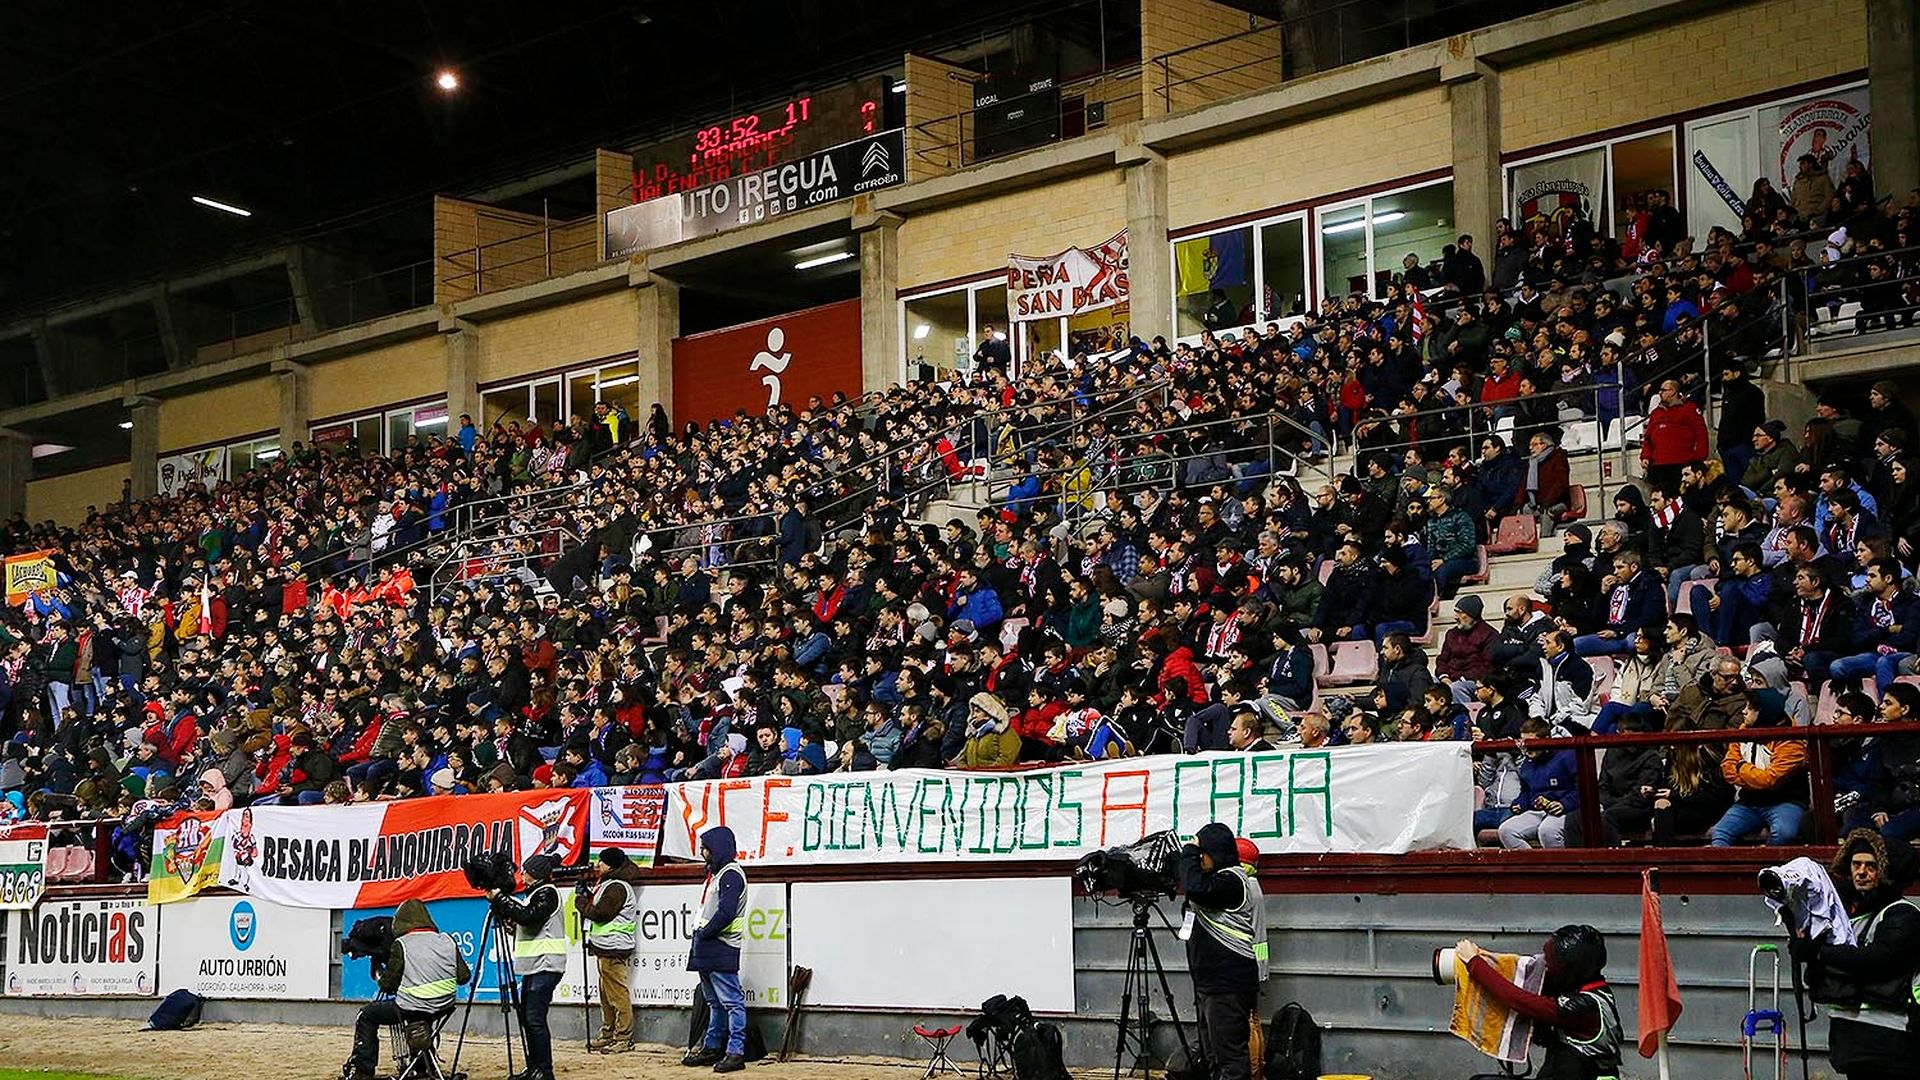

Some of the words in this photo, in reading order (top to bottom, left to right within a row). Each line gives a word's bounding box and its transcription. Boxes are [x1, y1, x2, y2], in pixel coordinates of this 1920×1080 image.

[976, 94, 999, 107] LOCAL
[695, 115, 759, 151] 33:52
[784, 98, 812, 125] 1T
[738, 154, 838, 208] IREGUA
[804, 185, 838, 205] .com
[1008, 262, 1070, 290] PEÑA
[1017, 288, 1063, 315] SAN
[1072, 273, 1129, 309] BLAS
[802, 770, 1083, 856] BIENVENIDOS
[1100, 769, 1150, 847] A
[1173, 751, 1332, 842] CASA
[261, 836, 341, 882] RESACA
[347, 820, 514, 882] BLANQUIRROJA
[18, 902, 145, 964] Noticias
[198, 959, 234, 976] AUTO
[237, 954, 287, 977] URBIÓN
